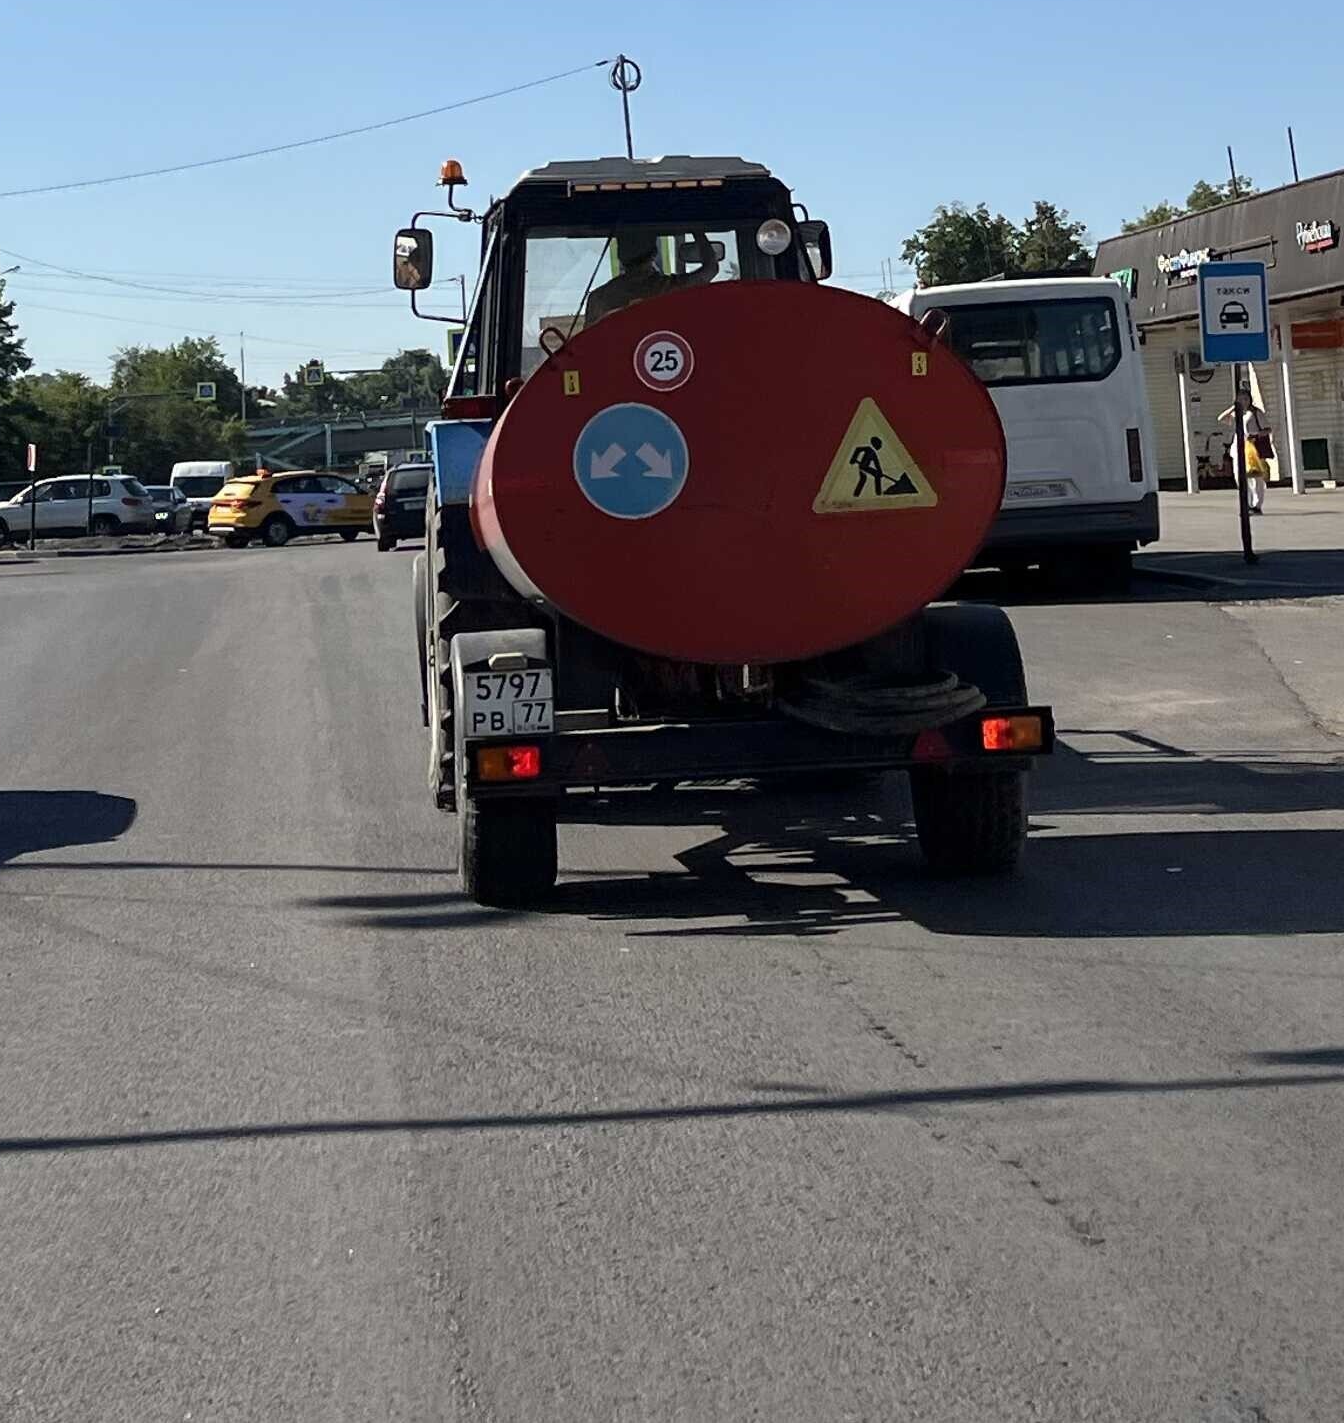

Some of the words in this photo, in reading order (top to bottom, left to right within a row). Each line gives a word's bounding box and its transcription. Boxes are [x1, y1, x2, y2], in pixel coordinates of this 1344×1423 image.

[650, 350, 678, 372] 25
[476, 673, 540, 700] 5797
[473, 712, 504, 733] РВ
[522, 703, 545, 723] 77
